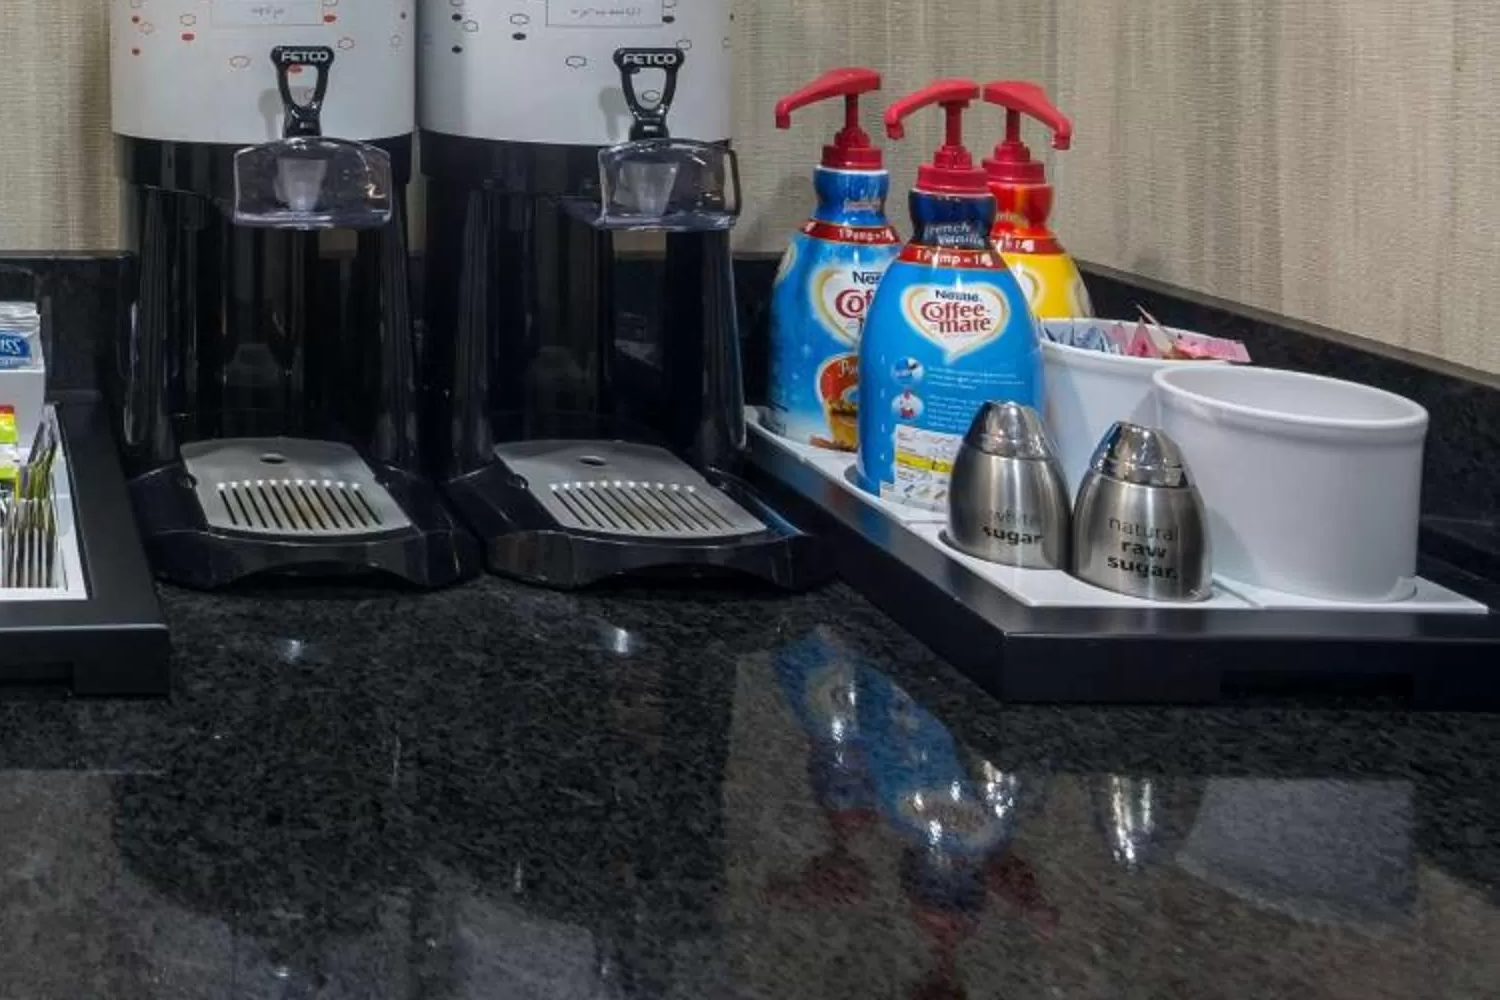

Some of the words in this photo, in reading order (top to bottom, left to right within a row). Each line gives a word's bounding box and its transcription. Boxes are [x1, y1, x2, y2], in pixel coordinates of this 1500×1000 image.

[282, 51, 329, 62] FETCO
[623, 53, 677, 65] FETCO
[938, 317, 992, 333] mate
[1107, 517, 1179, 542] natural
[1121, 541, 1168, 559] raw
